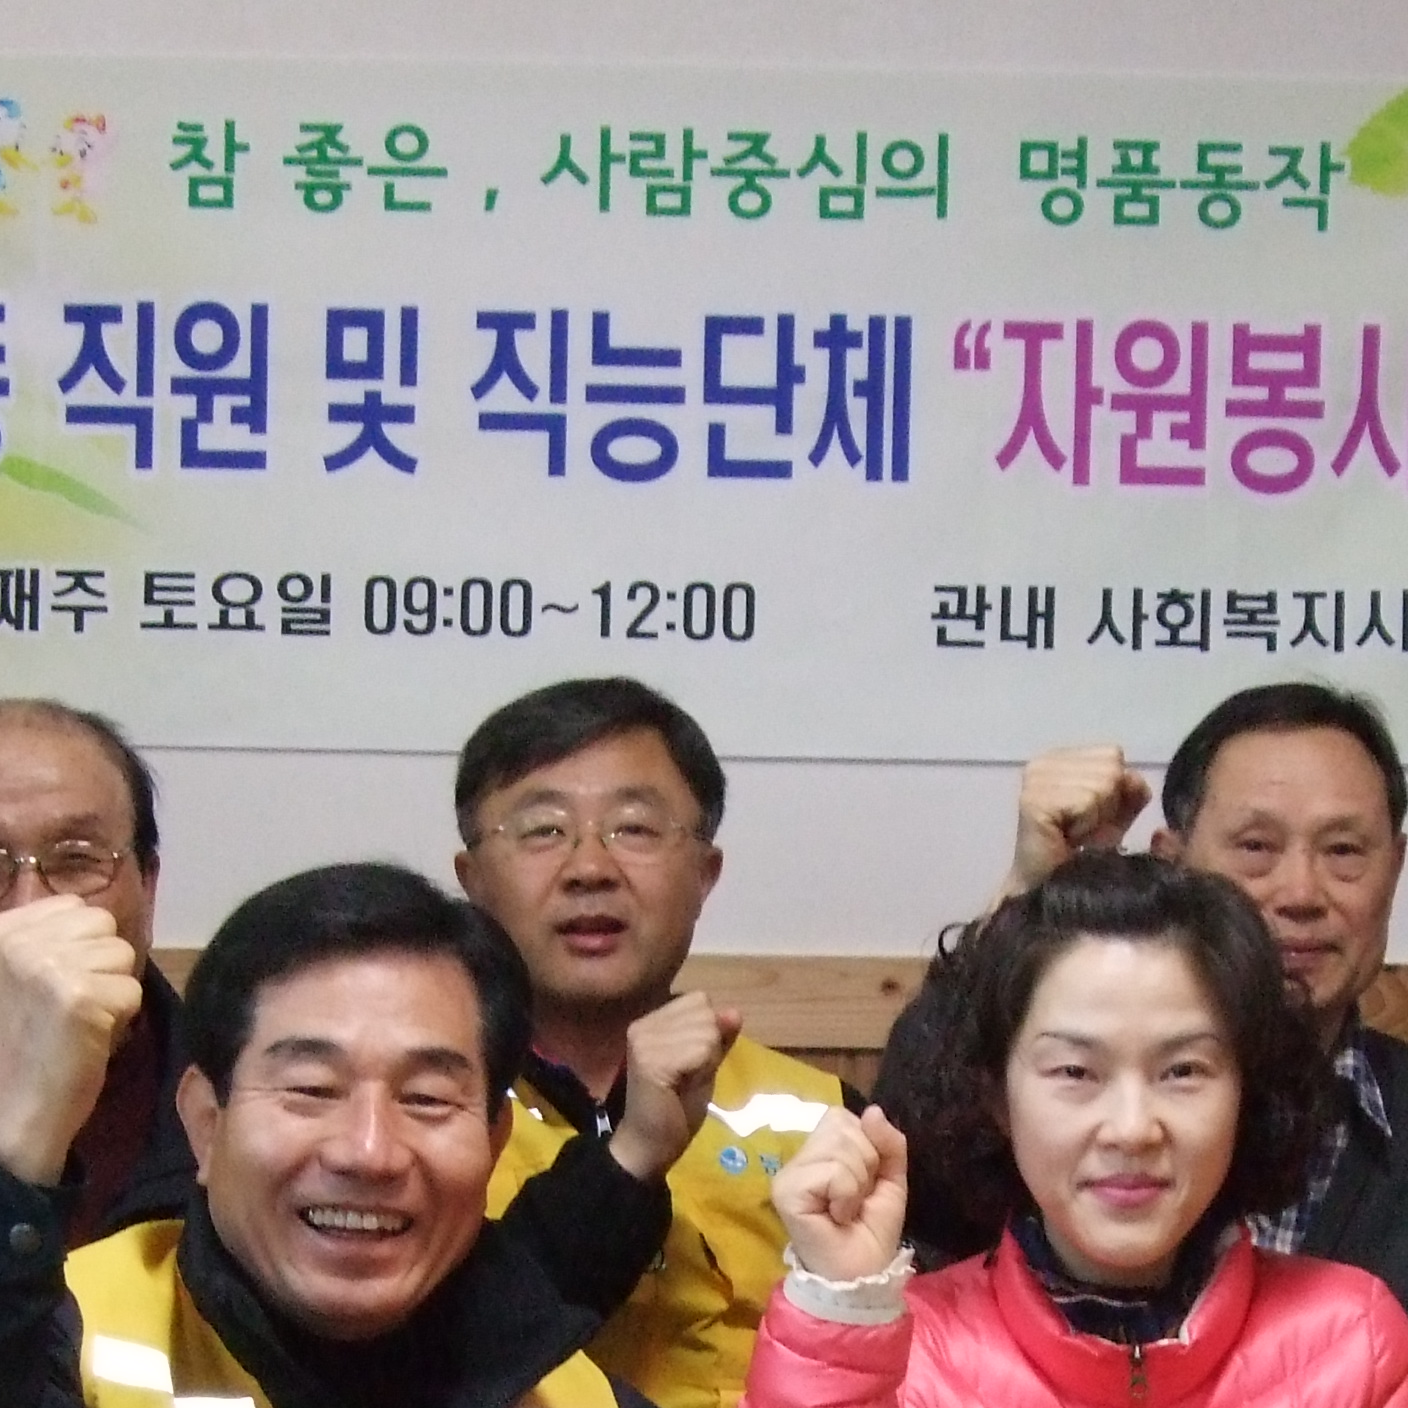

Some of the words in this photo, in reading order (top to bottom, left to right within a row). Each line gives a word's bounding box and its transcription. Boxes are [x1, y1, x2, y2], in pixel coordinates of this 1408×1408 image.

[169, 119, 251, 209] 참
[540, 125, 952, 221] 사람중심의
[1017, 134, 1346, 232] 명품동작
[57, 301, 272, 472] 직원
[323, 306, 421, 475] 및
[470, 308, 914, 484] 직능단체
[139, 571, 332, 637] 토요일
[363, 575, 756, 643] 09:00~12:00
[930, 583, 1056, 651] 관내
